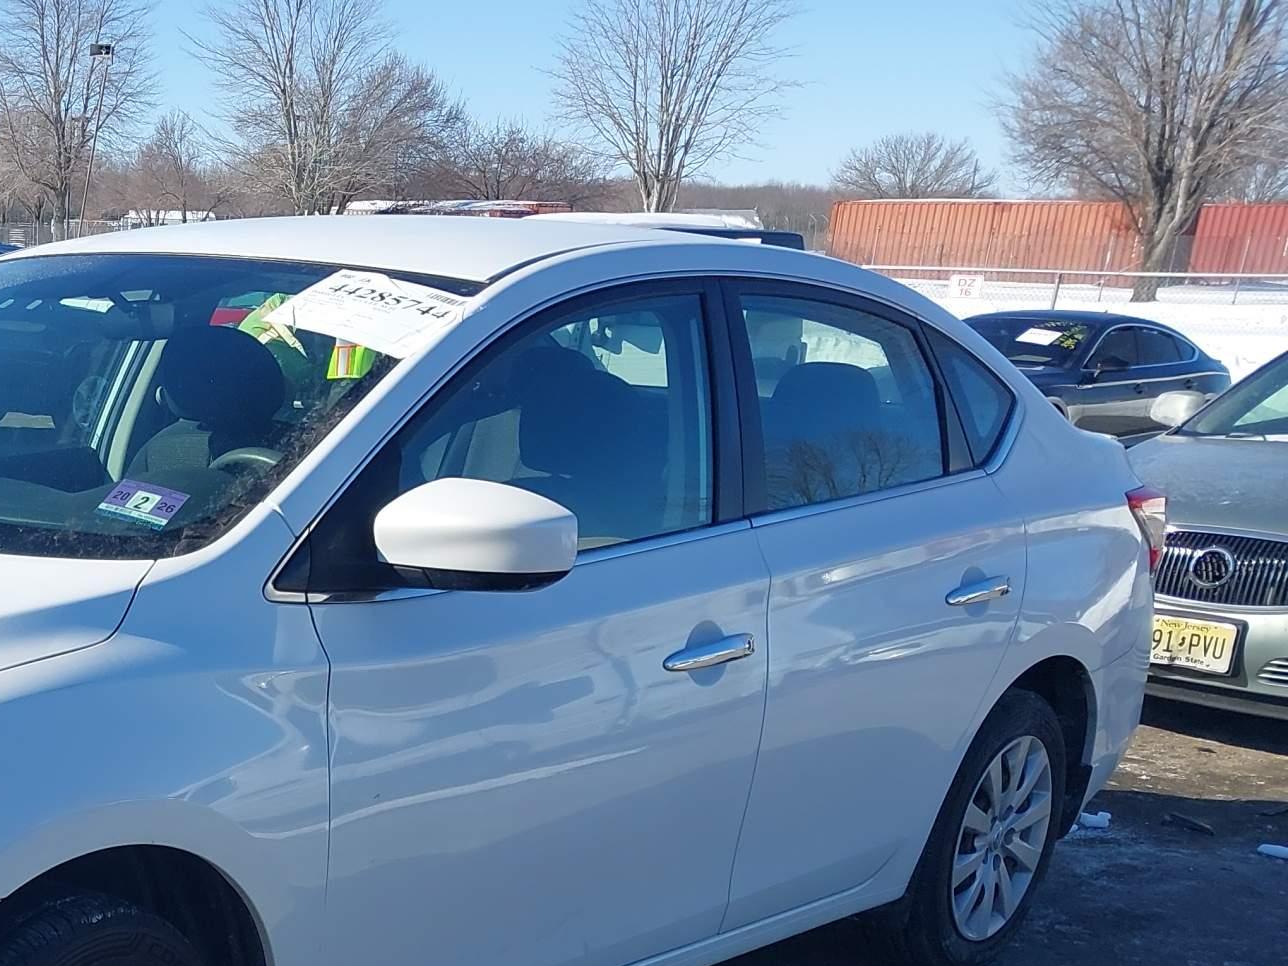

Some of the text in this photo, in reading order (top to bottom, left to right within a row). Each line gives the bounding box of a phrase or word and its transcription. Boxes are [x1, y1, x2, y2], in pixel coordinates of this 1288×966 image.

[957, 278, 976, 287] DZ
[959, 287, 972, 296] 16
[328, 283, 450, 319] 44285744
[112, 490, 176, 513] 20 2 26
[1160, 618, 1210, 633] New Jersey
[1185, 656, 1205, 666] State
